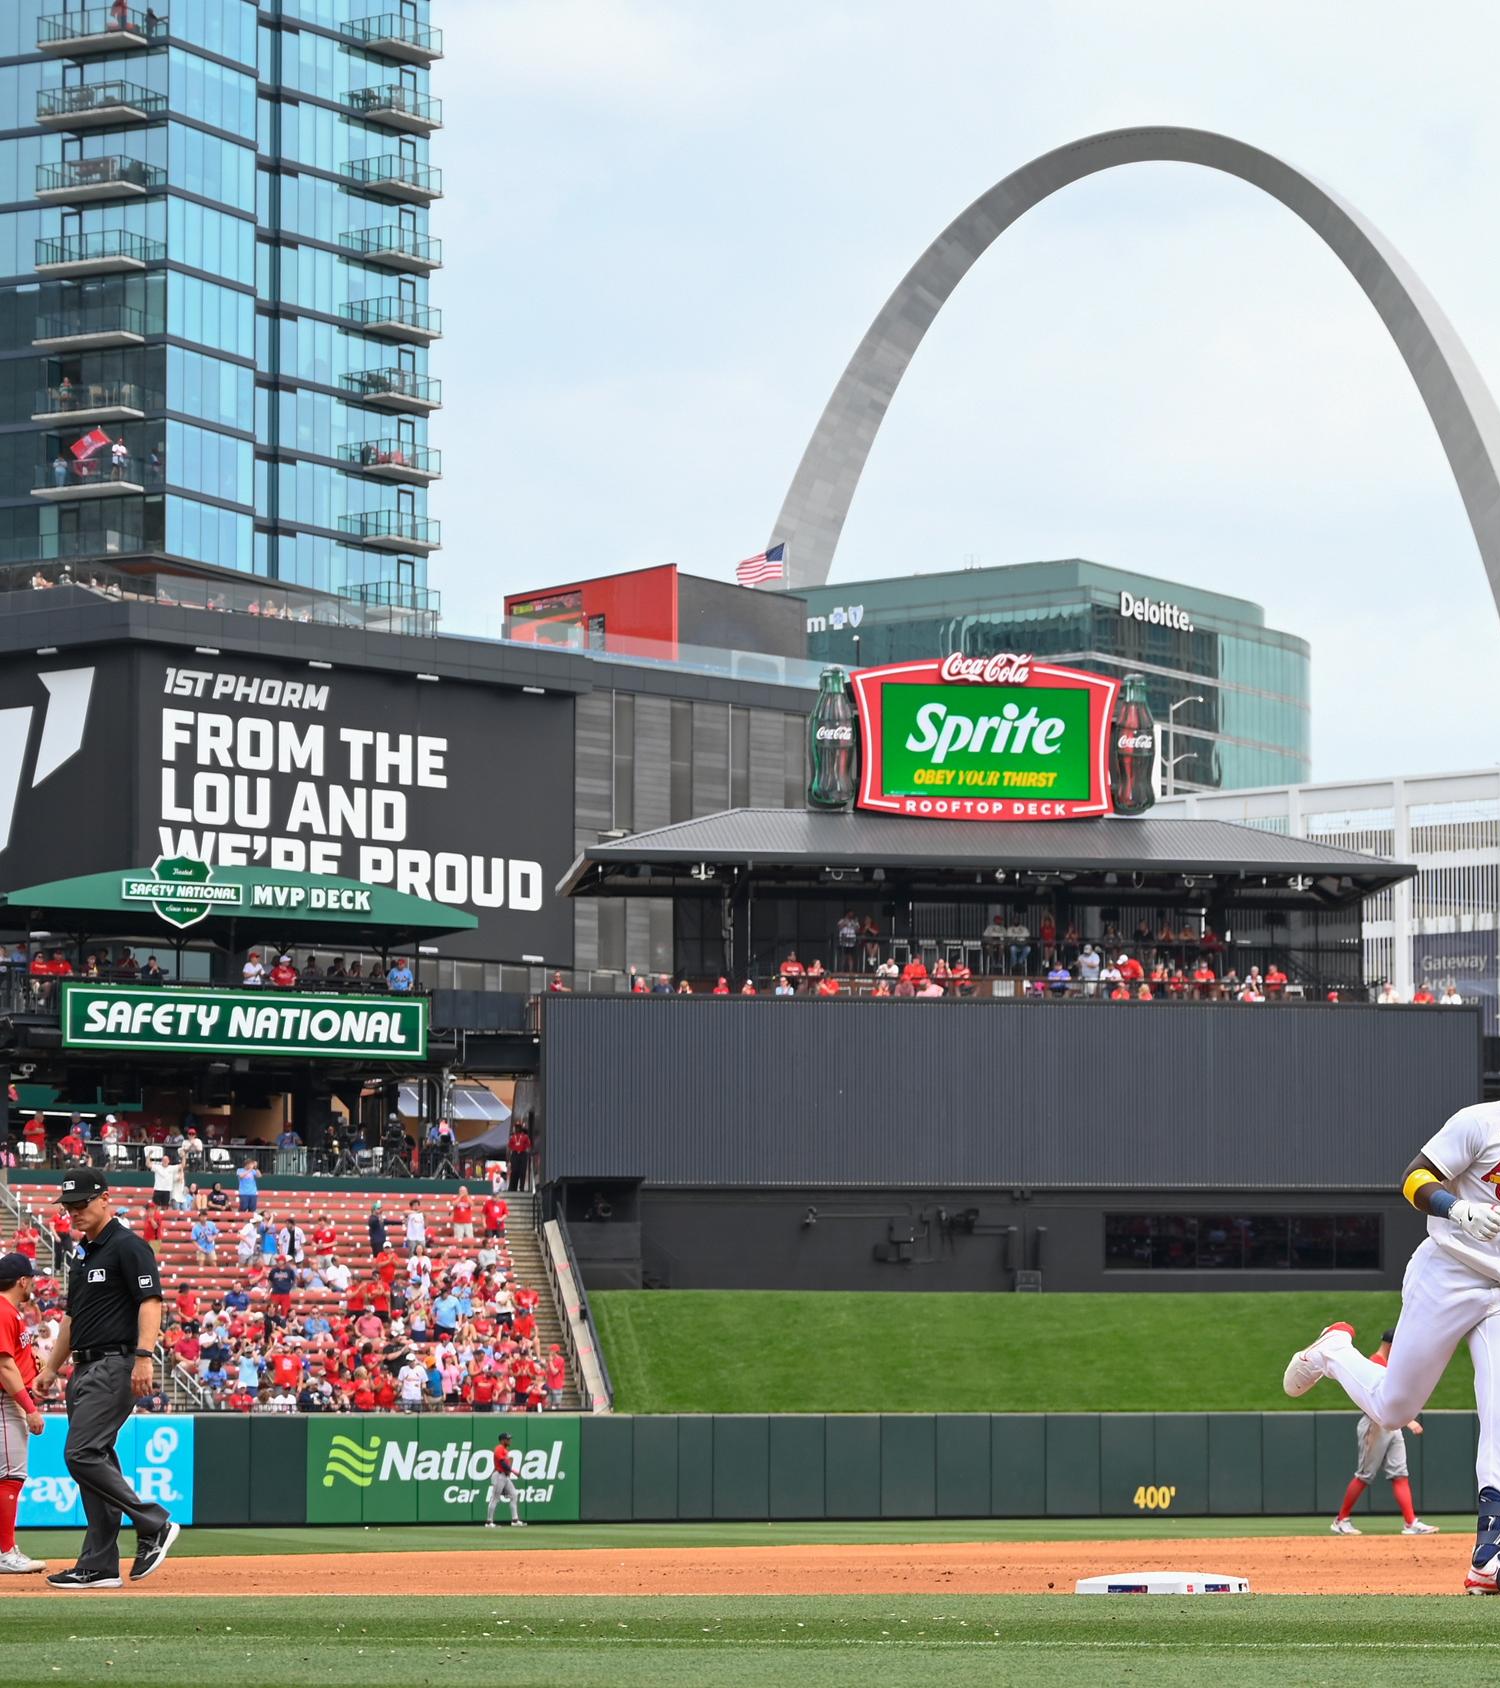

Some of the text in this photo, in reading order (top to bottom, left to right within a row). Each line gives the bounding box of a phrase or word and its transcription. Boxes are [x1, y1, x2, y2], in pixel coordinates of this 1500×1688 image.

[941, 652, 1032, 683] Coca-Cola
[164, 667, 330, 711] 1ST PHORM
[161, 707, 448, 788] FROM THE
[905, 702, 1065, 764] Sprite
[913, 769, 1057, 787] OBEY YOUR THIRST
[161, 767, 407, 842] LOU AND
[905, 800, 1067, 816] ROOFTOP DECK
[129, 882, 237, 900] SAFETY NATIONAL
[359, 845, 543, 911] PROUD
[253, 884, 372, 911] MVP DECK
[1423, 954, 1488, 972] Gateway
[84, 1000, 407, 1044] SAFETY NATIONAL
[443, 1486, 479, 1503] Car
[1133, 1486, 1176, 1510] 400'
